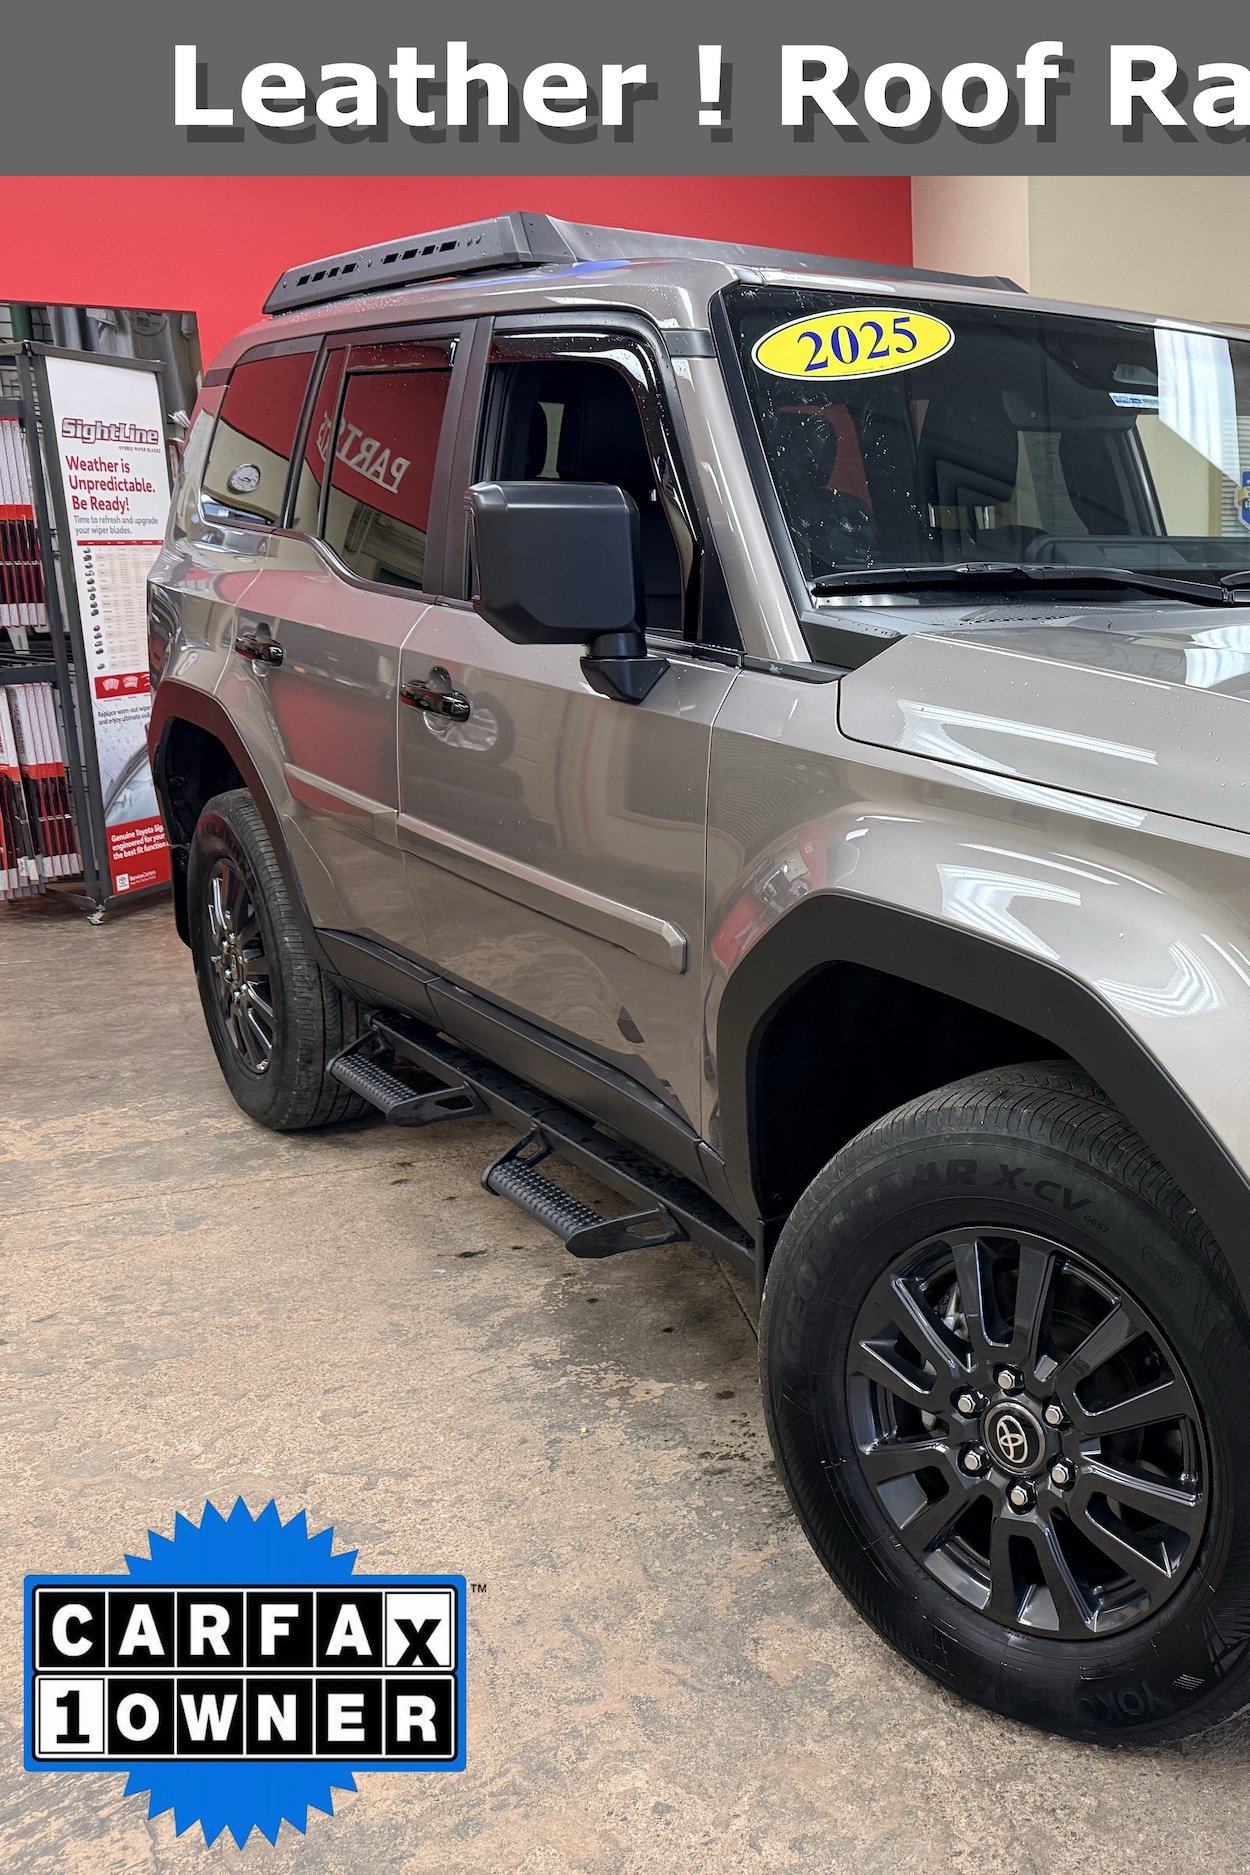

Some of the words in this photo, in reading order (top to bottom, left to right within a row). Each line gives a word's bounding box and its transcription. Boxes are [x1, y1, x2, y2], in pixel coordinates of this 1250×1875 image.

[797, 316, 918, 372] 2025
[61, 417, 159, 445] SightLine
[65, 455, 119, 473] Weather
[120, 458, 131, 473] is
[68, 474, 156, 494] Unpredictable.
[71, 495, 88, 511] Be
[90, 495, 130, 514] Ready!
[73, 515, 89, 524] Time
[90, 516, 98, 524] to
[99, 515, 120, 524] refresh
[121, 516, 133, 524] and
[134, 516, 158, 527] upgrade
[75, 527, 90, 536] your
[91, 526, 109, 536] wiper
[110, 526, 132, 534] blades.
[111, 831, 135, 842] Genuine
[135, 828, 154, 838] Toyota
[113, 852, 124, 860] the
[124, 849, 137, 857] best
